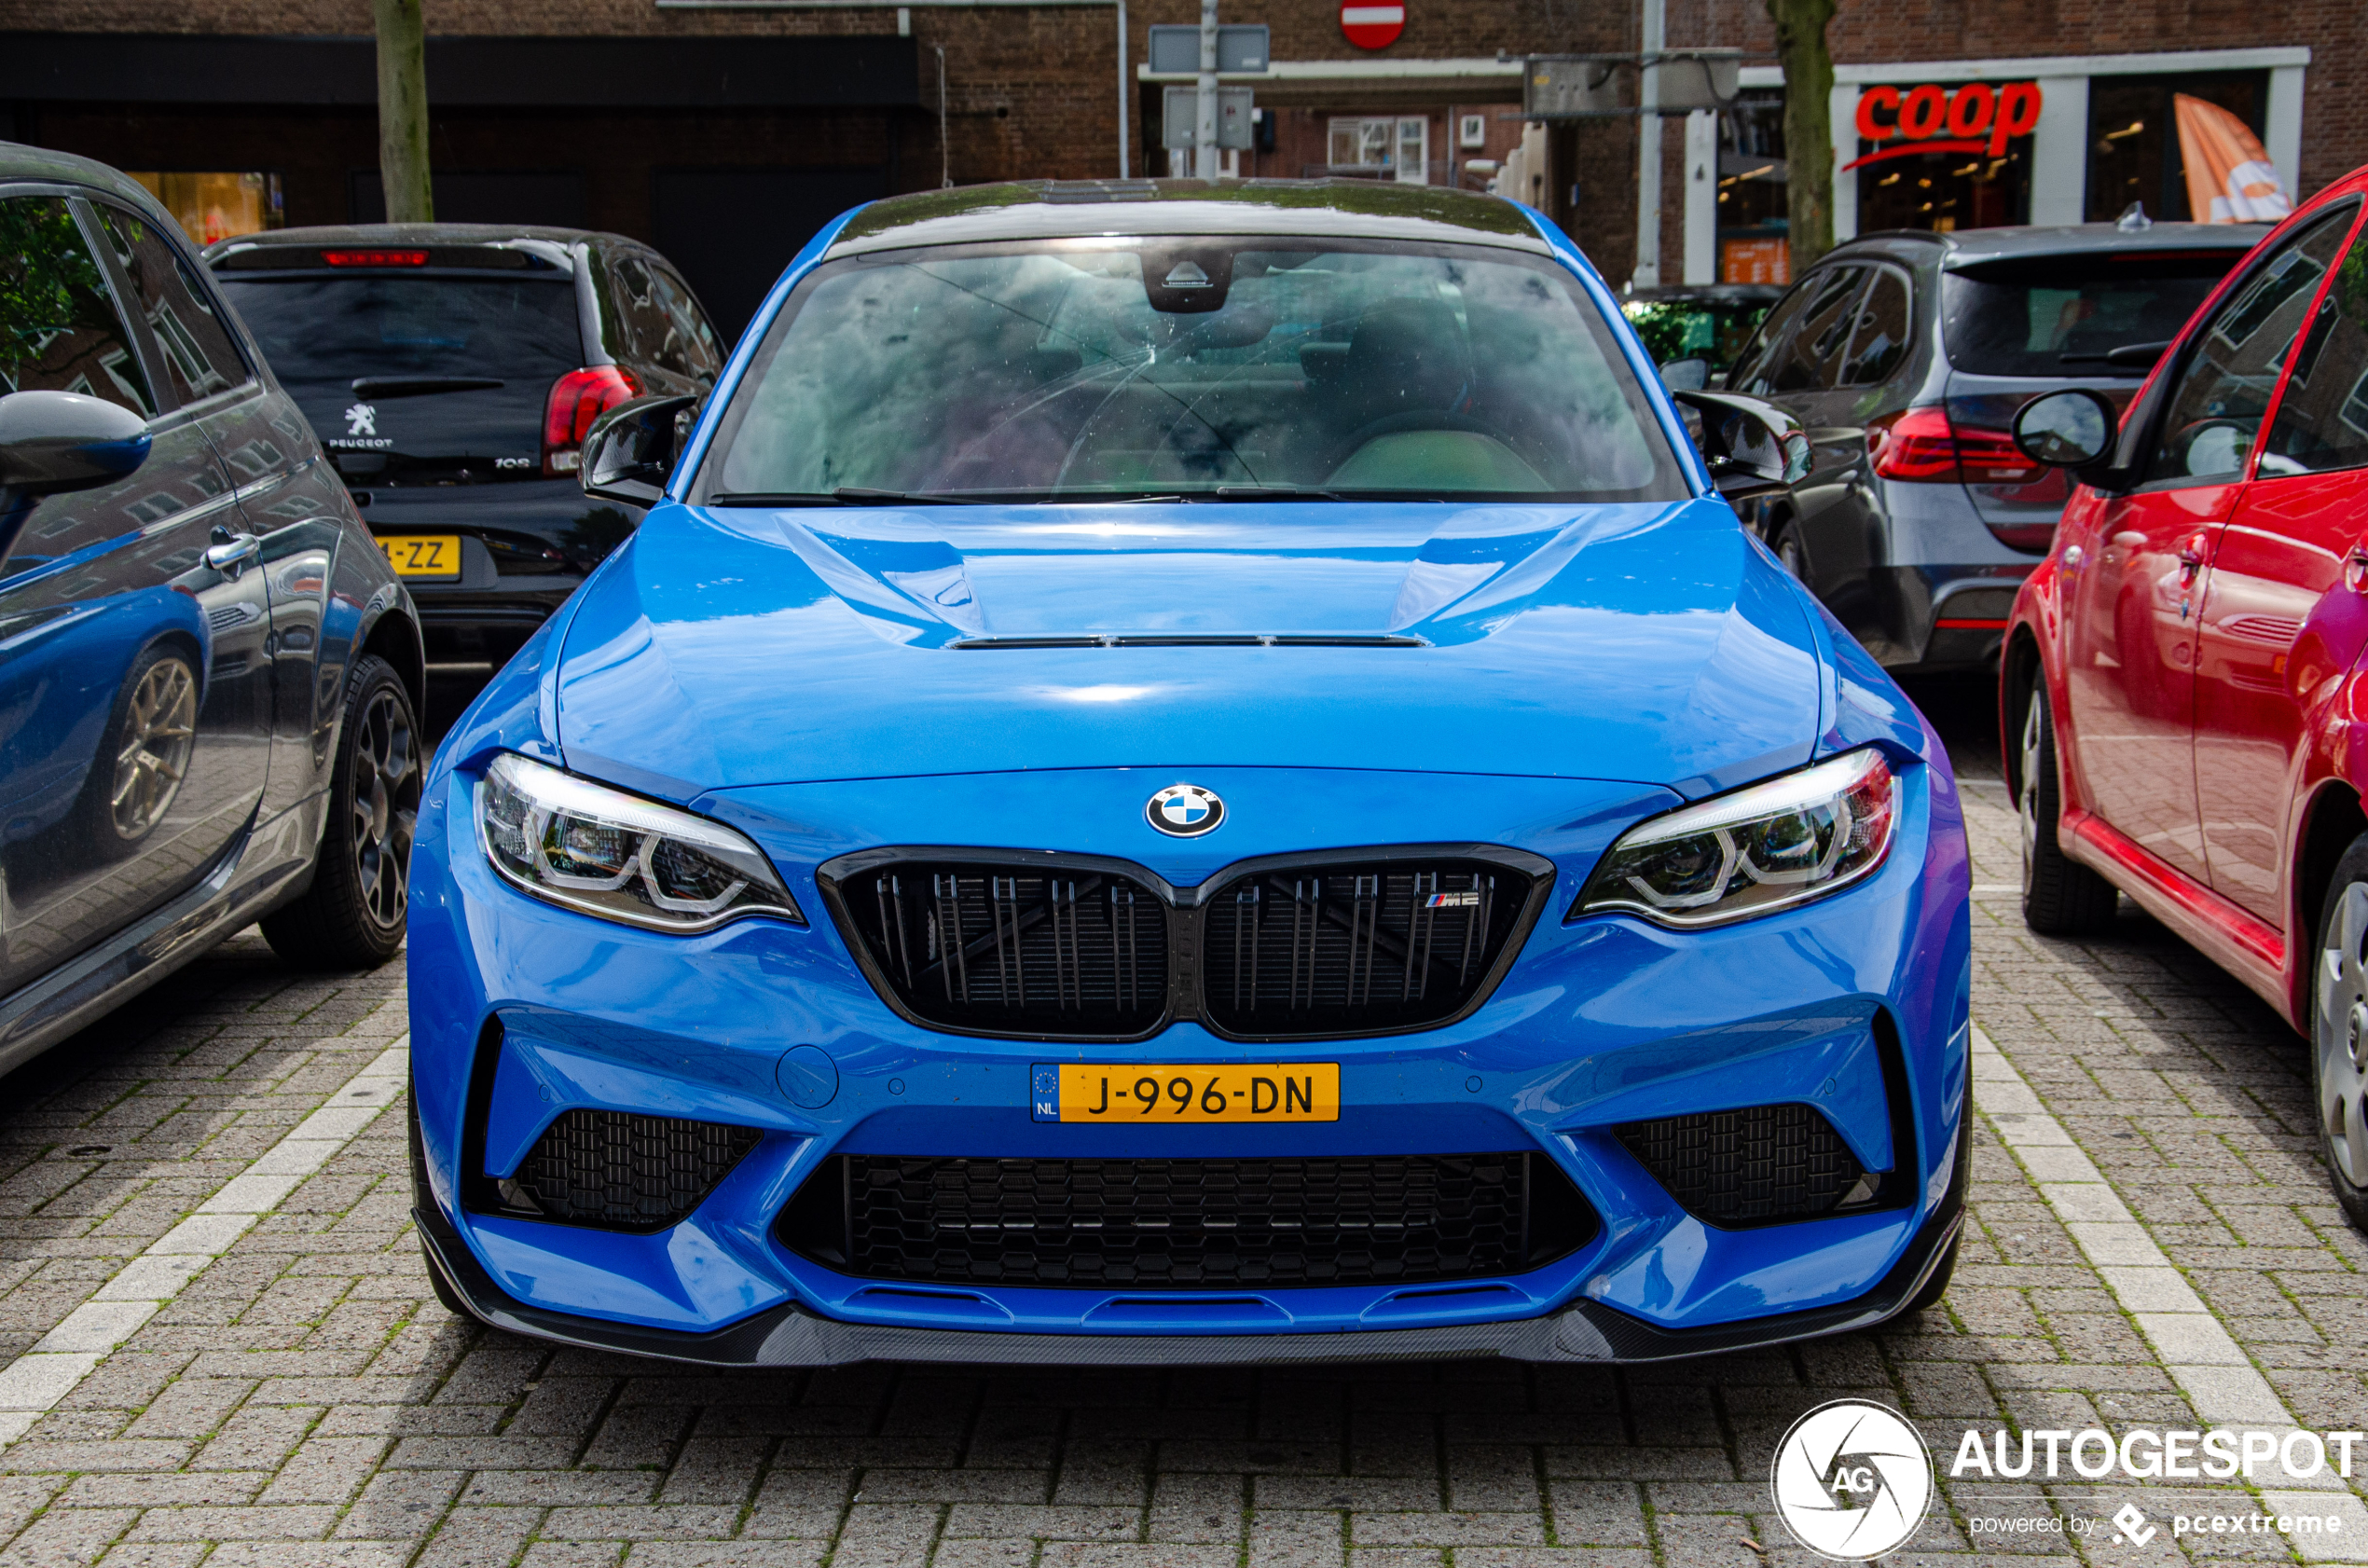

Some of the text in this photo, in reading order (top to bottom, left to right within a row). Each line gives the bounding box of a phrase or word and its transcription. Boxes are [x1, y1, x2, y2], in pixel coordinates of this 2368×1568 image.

[1855, 82, 2043, 158] coop
[329, 439, 392, 447] PEUGEOT
[1439, 892, 1480, 907] M2
[1088, 1076, 1313, 1115] J-996-DN
[1037, 1102, 1057, 1115] NL
